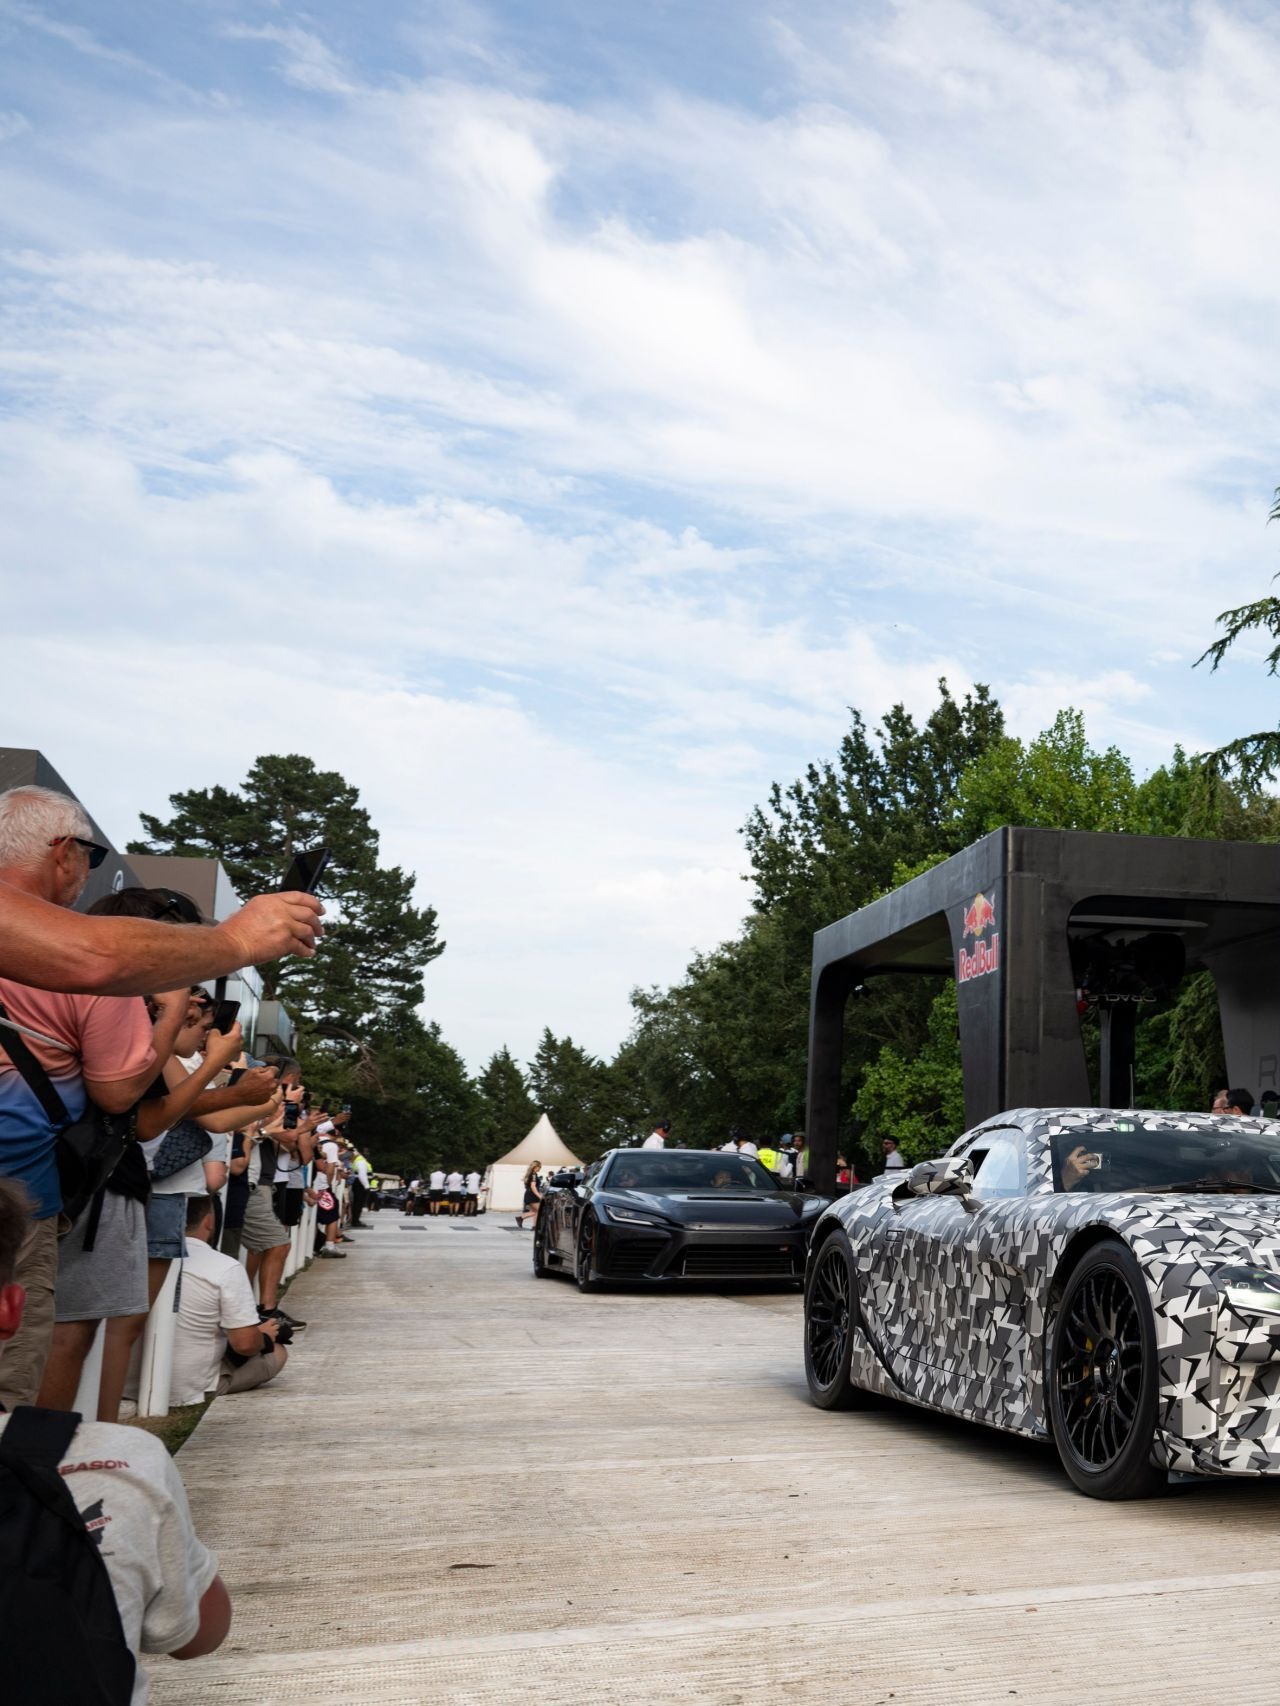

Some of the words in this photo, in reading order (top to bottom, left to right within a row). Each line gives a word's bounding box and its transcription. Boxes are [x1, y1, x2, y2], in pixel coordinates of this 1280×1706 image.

[959, 940, 980, 983] Red
[979, 932, 999, 976] Bull
[58, 1460, 130, 1475] EASON
